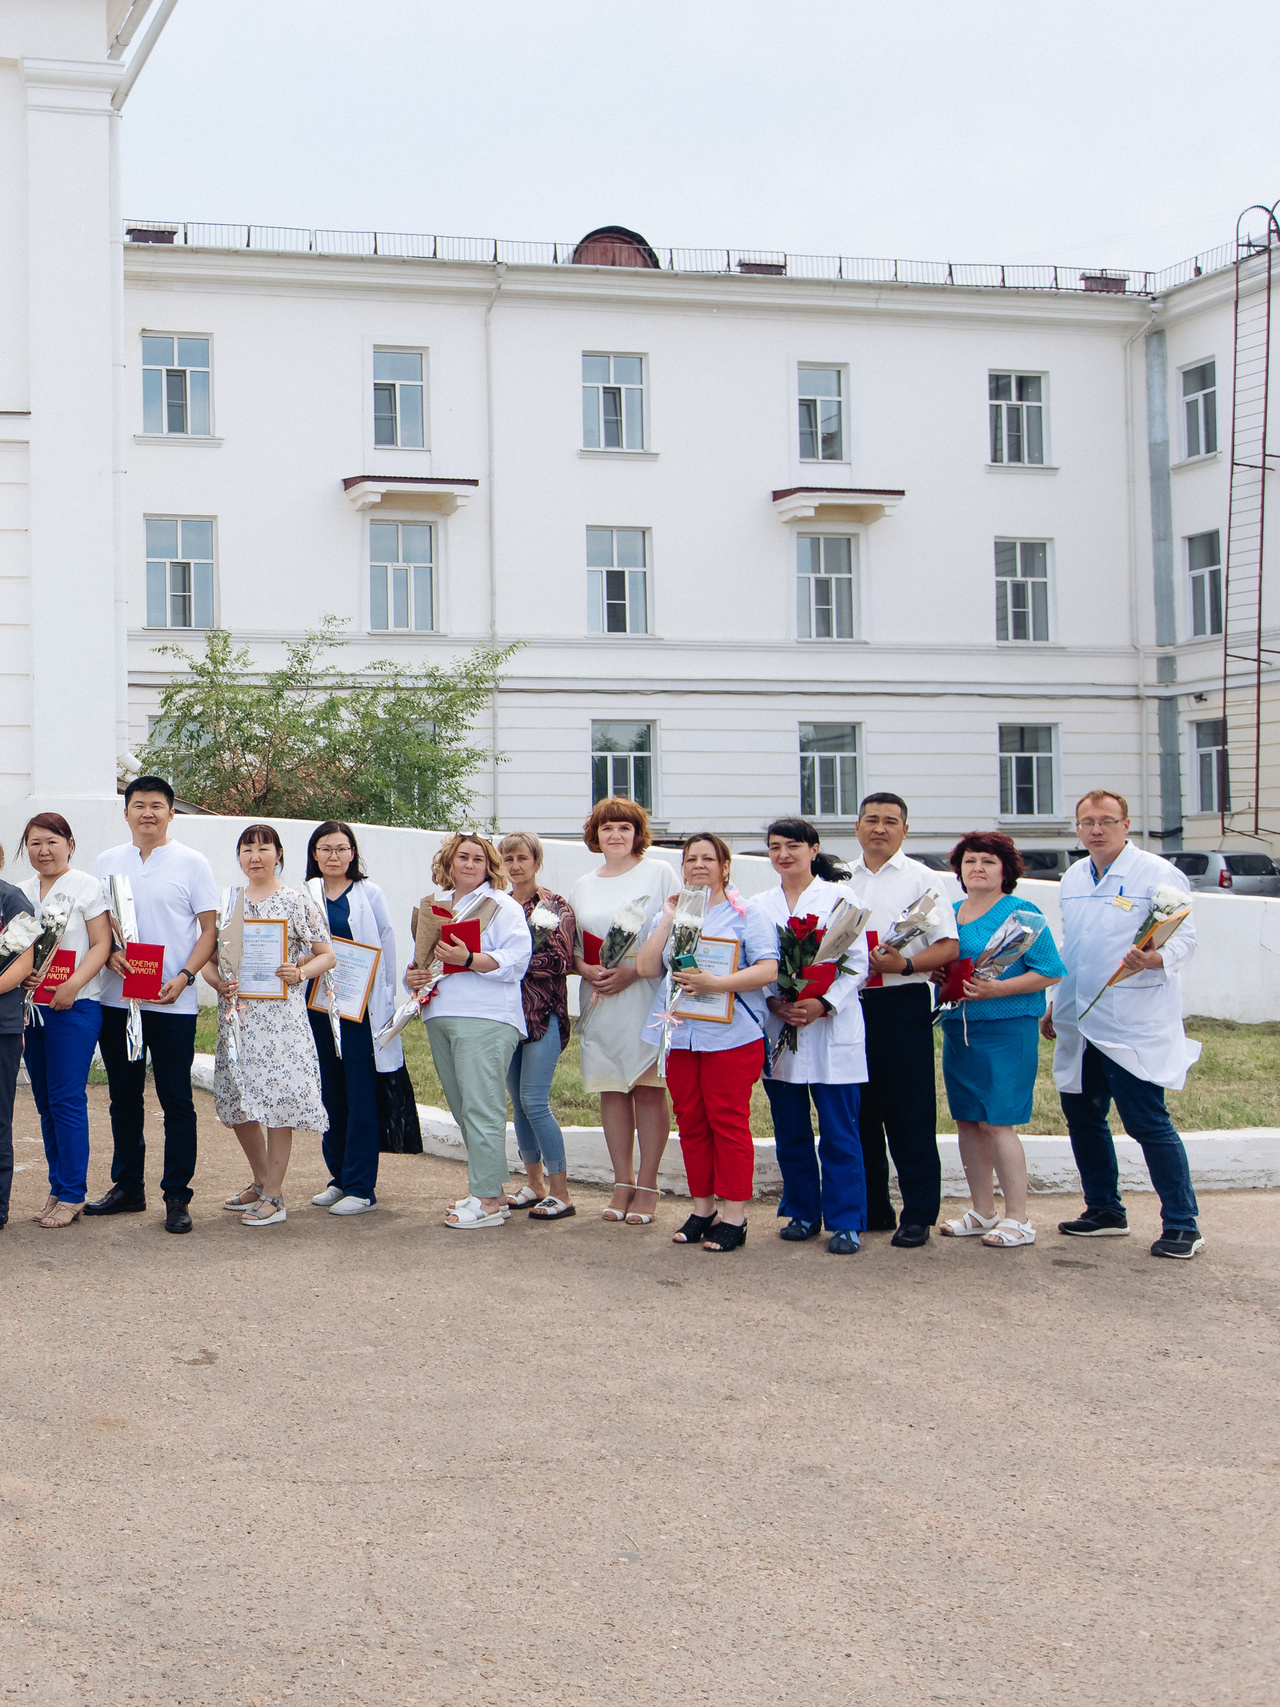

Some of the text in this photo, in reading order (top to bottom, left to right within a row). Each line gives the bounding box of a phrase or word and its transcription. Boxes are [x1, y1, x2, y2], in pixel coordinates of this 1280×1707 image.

[128, 958, 159, 969] ПОЧЕТНАЯ
[50, 965, 70, 975] ЕТНАЯ
[133, 966, 157, 976] РАМОТА
[46, 973, 68, 981] АМОТА
